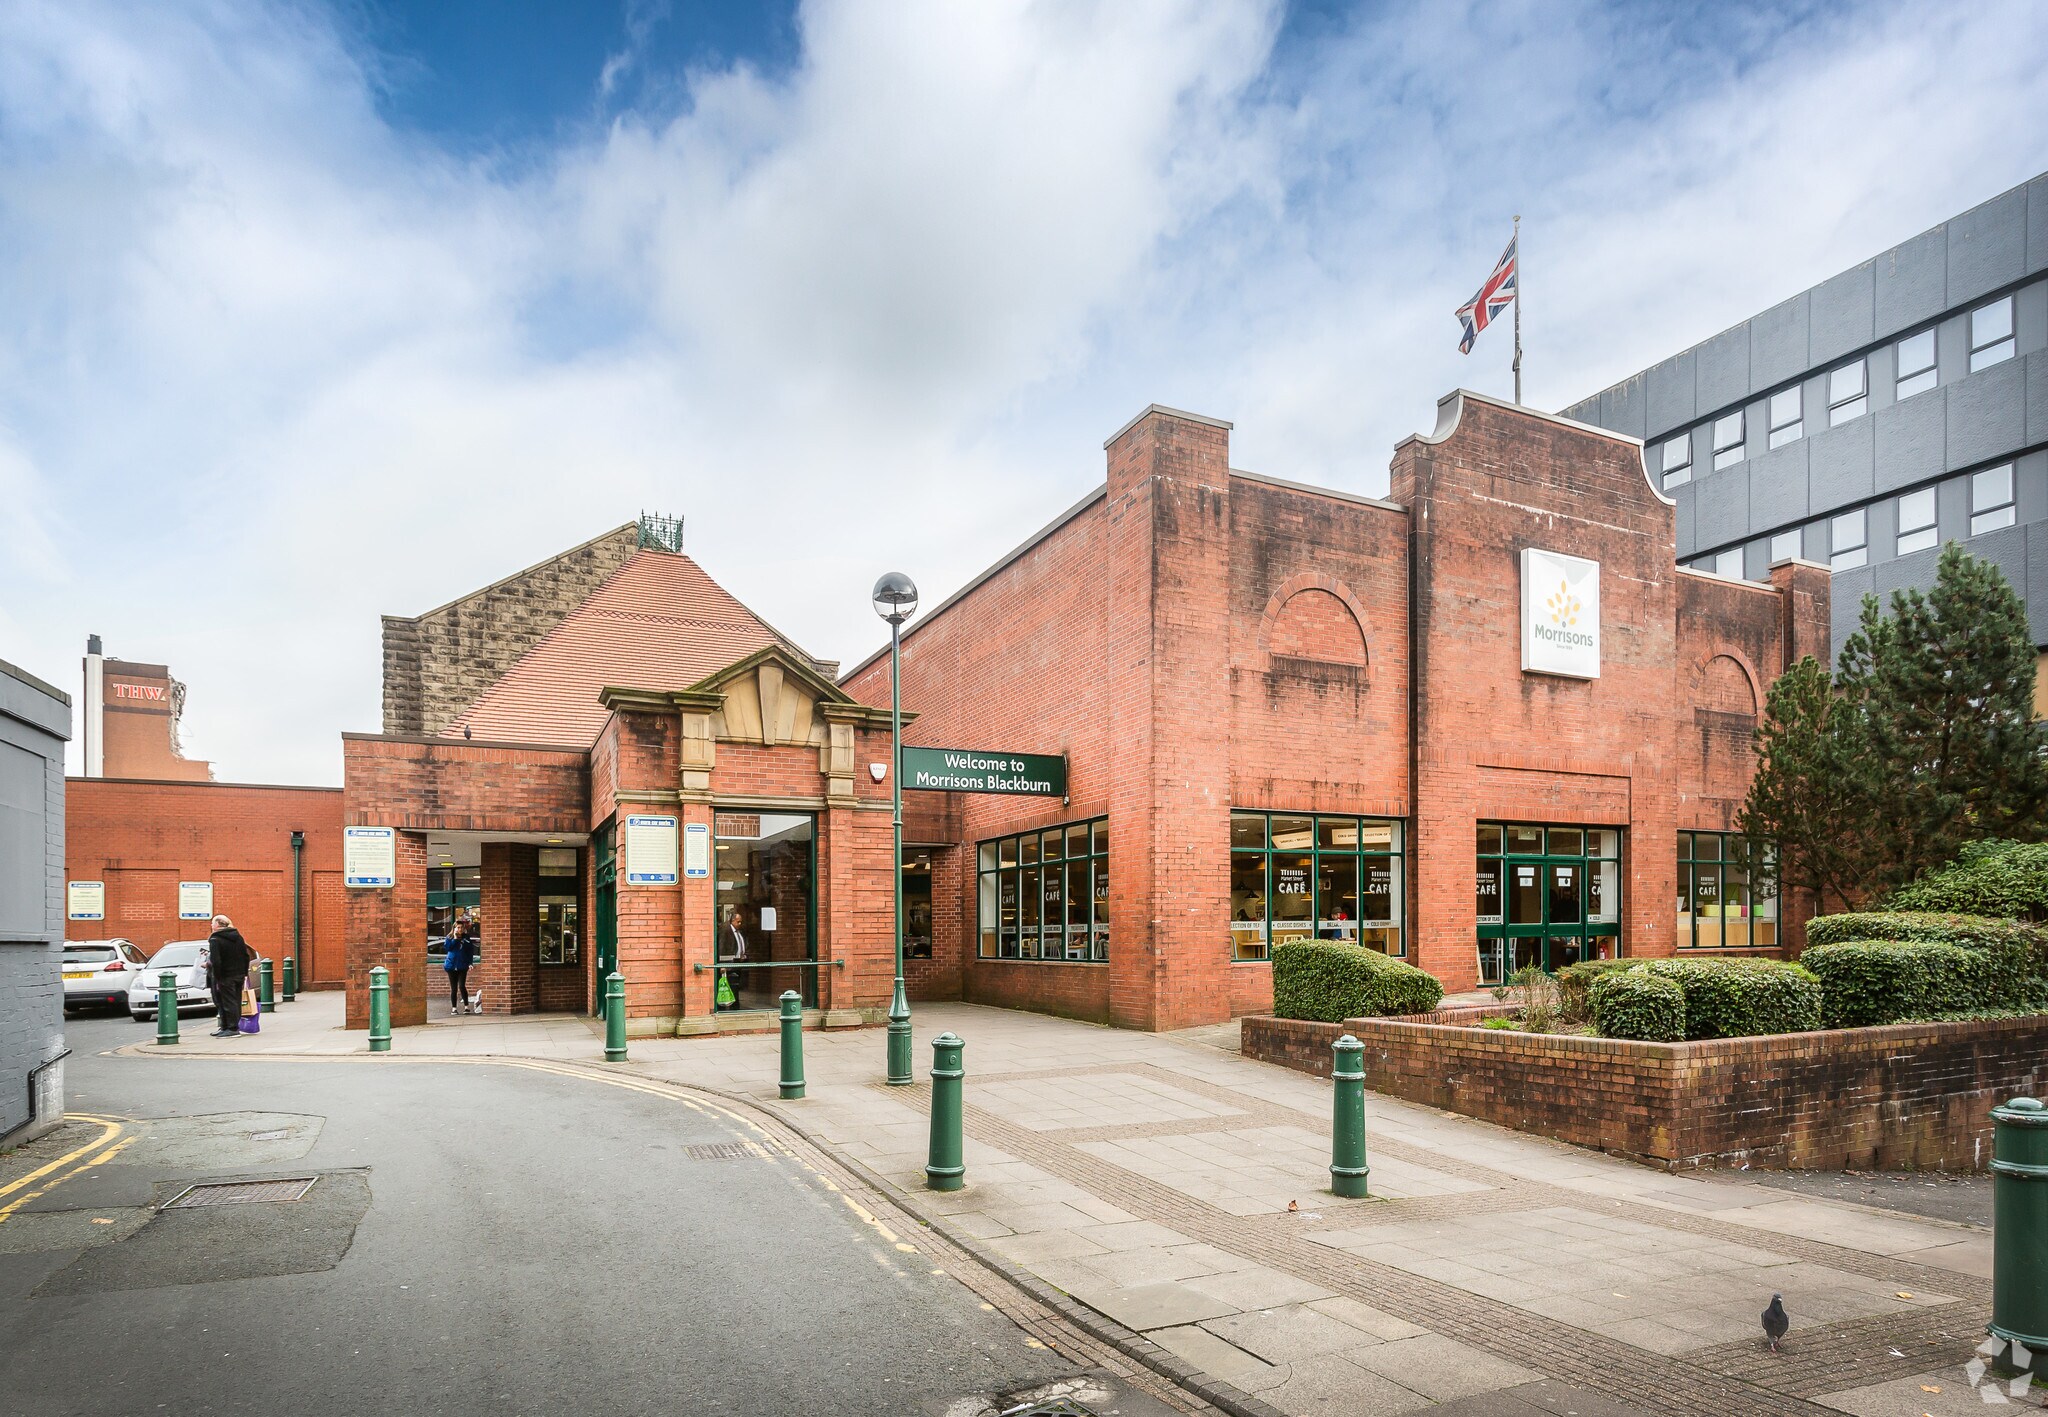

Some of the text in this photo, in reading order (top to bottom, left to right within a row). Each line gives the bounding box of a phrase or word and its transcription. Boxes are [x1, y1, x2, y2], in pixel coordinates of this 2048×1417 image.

[1535, 624, 1593, 647] Morrisons
[113, 683, 164, 700] THW
[944, 753, 1025, 772] Welcome to
[916, 771, 1051, 792] Morrisons Blackburn
[1096, 886, 1109, 898] CAF
[1279, 881, 1306, 894] CAFÉ
[1699, 886, 1716, 895] CAFÉ
[1002, 894, 1015, 904] CAFÉ
[1045, 889, 1060, 901] CAFÉ
